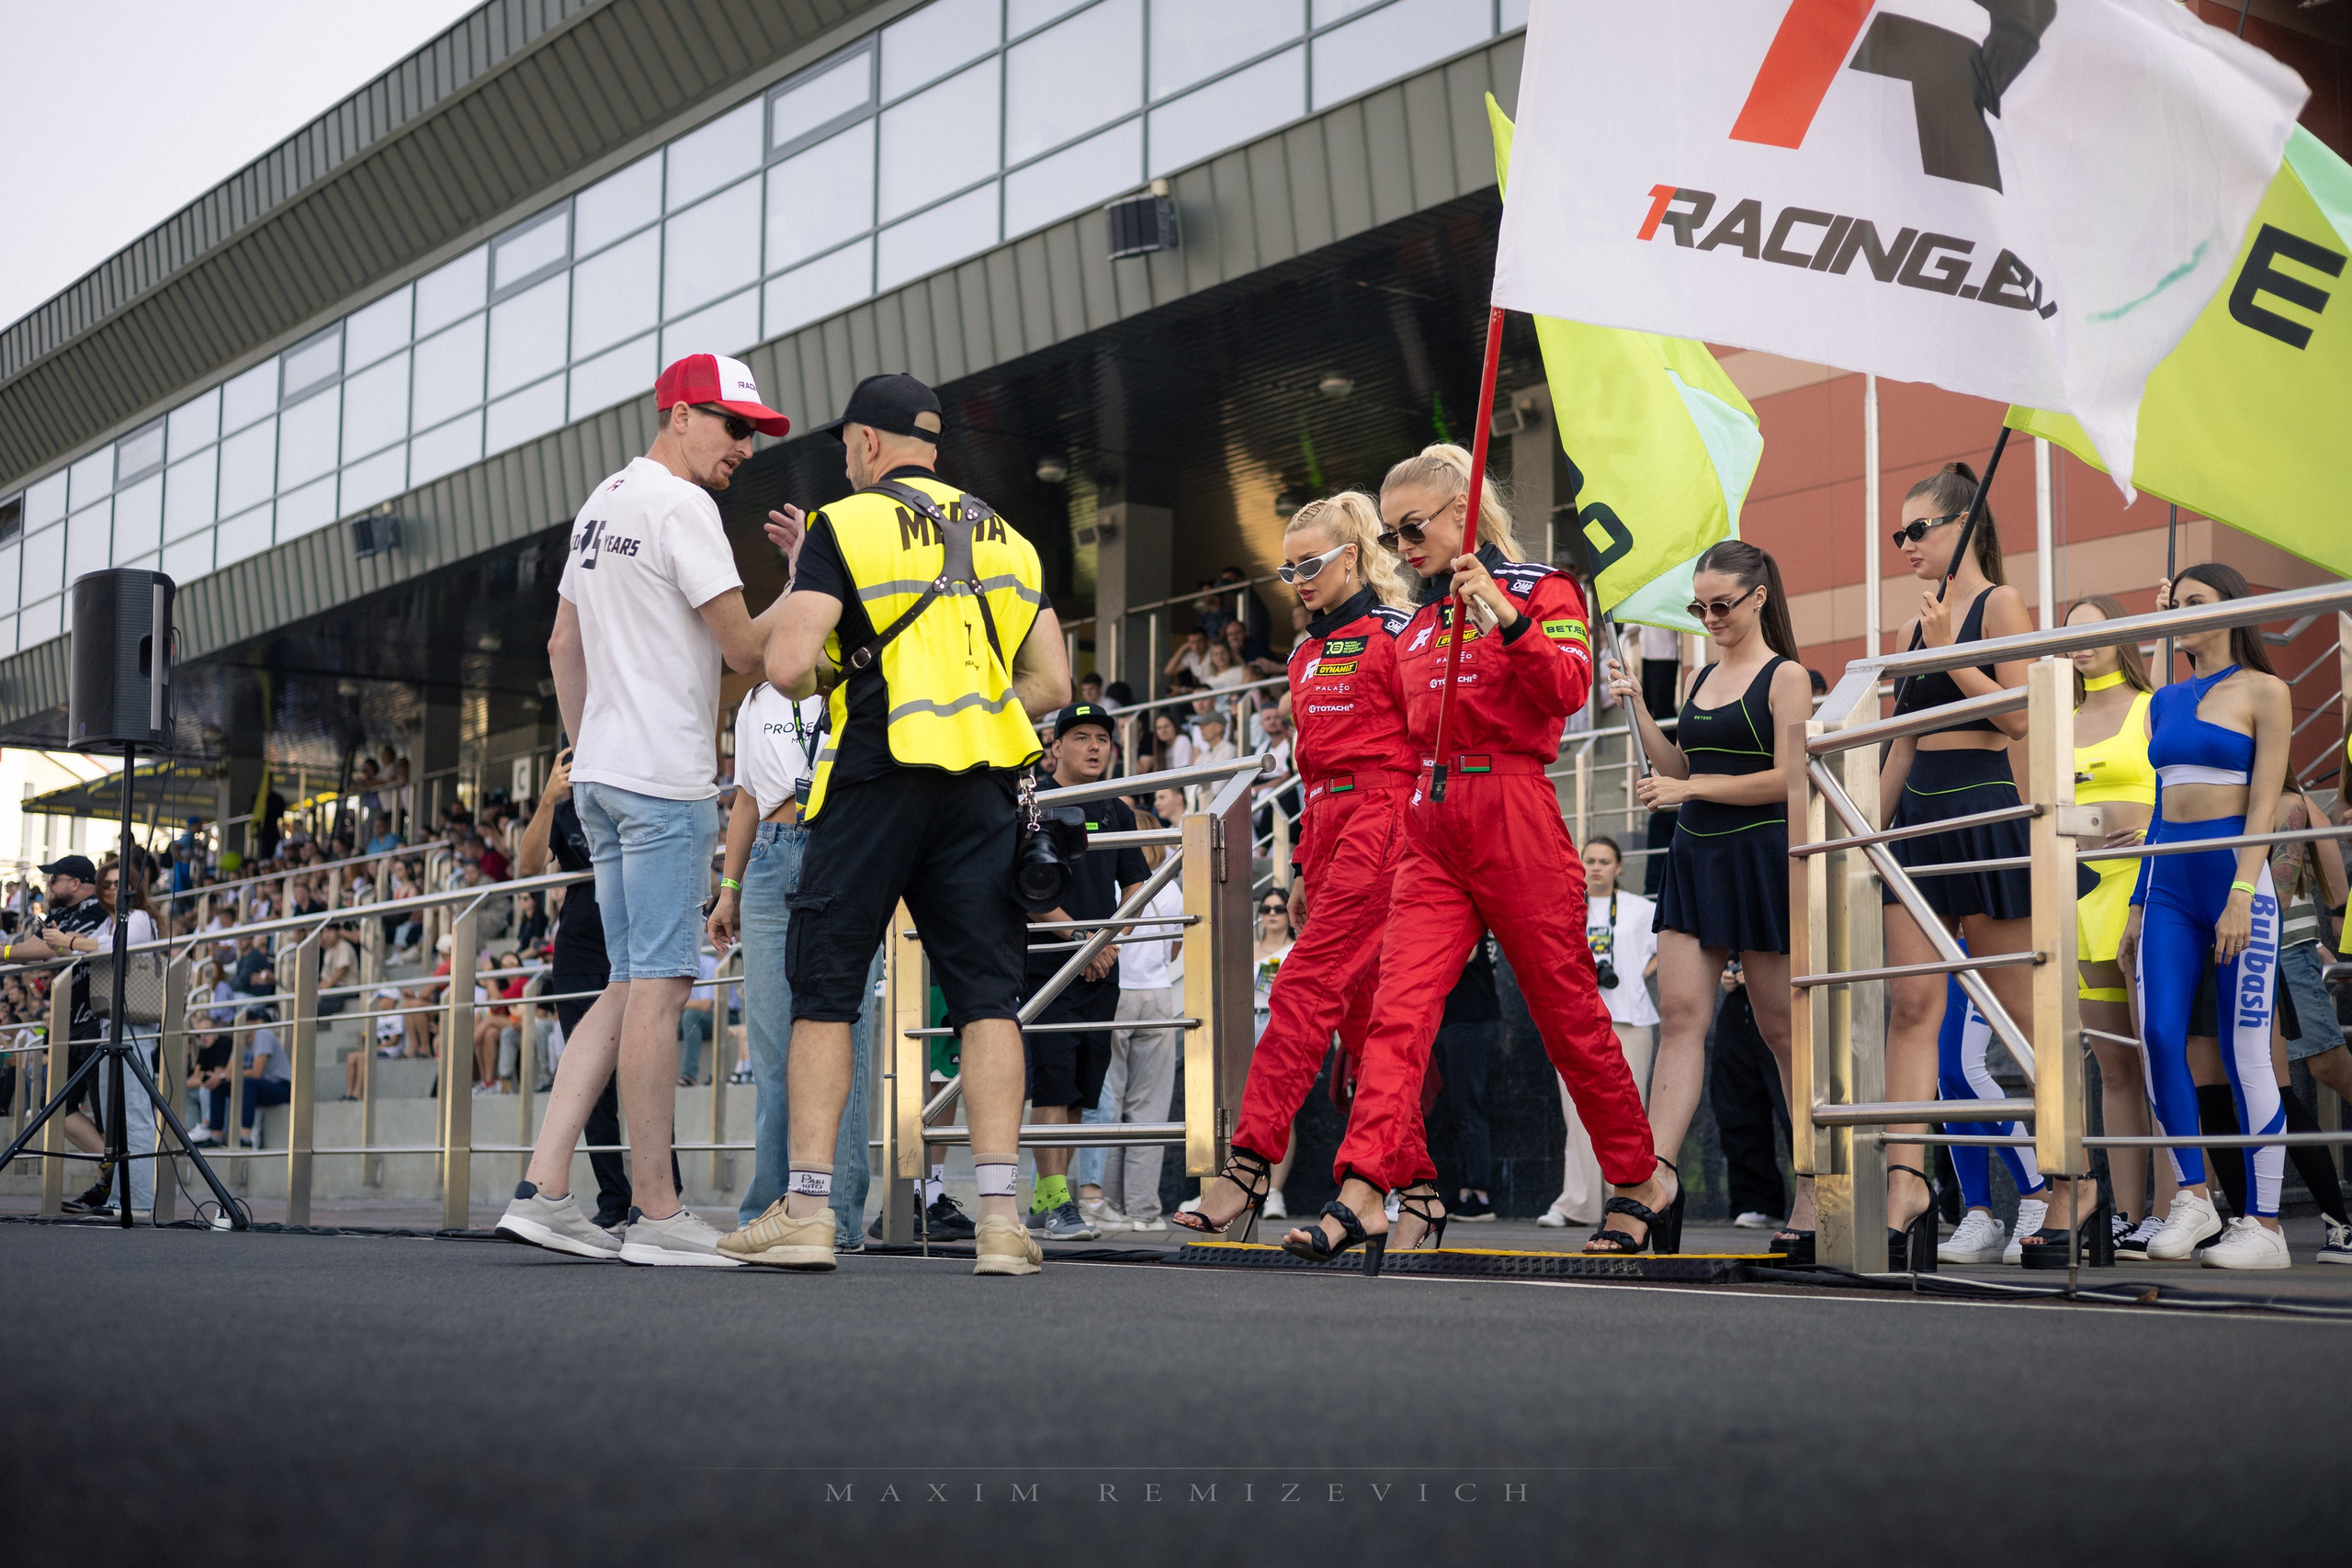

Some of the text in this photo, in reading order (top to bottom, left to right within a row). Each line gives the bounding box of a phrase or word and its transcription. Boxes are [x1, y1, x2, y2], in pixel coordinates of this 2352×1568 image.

[580, 519, 607, 570] 15
[604, 536, 641, 558] YEARS
[1512, 581, 1533, 592] OMP
[517, 764, 526, 791] C
[2238, 894, 2277, 1029] Bulbash
